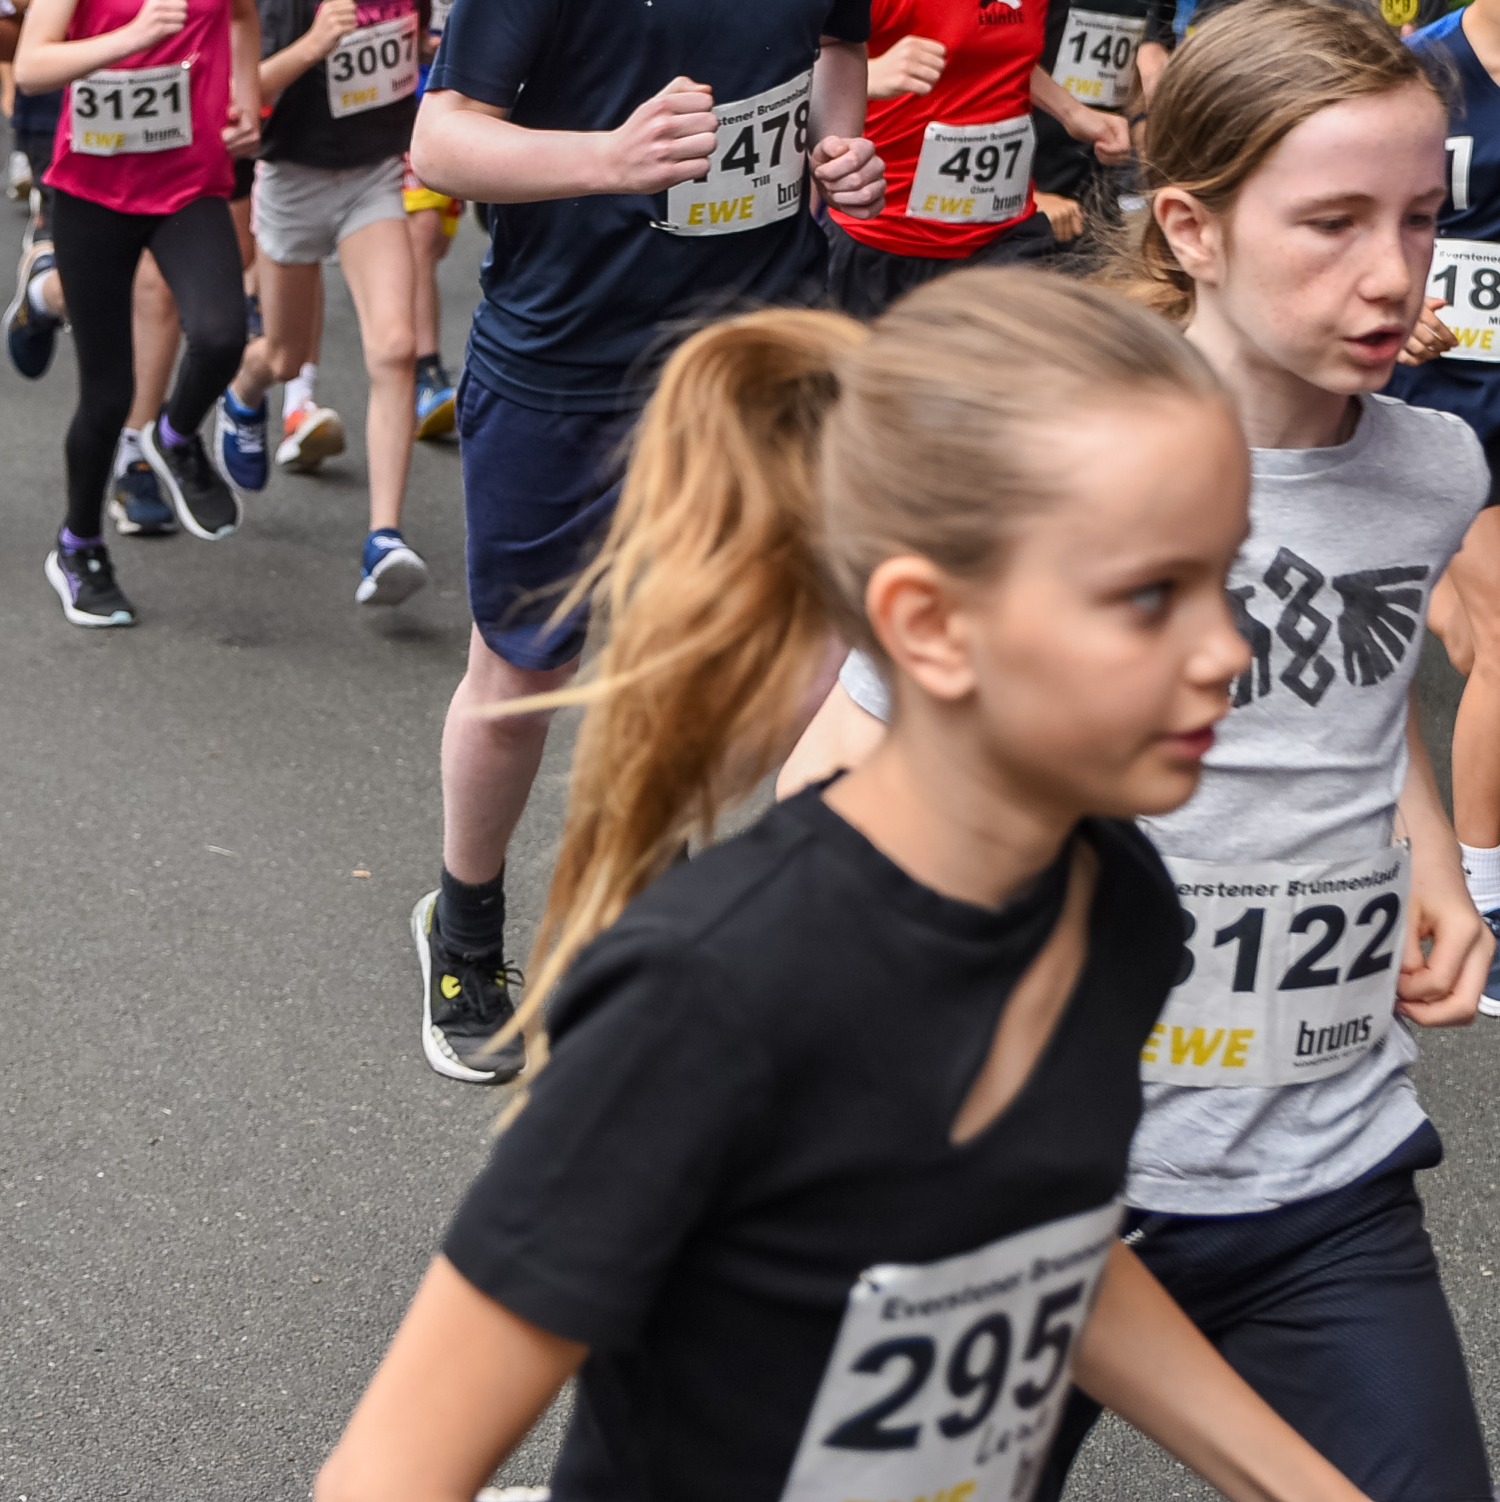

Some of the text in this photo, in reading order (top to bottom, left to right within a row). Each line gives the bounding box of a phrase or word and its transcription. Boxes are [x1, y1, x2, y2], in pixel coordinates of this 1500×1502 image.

[332, 31, 416, 83] 3007
[1069, 30, 1138, 70] 140
[76, 81, 181, 120] 3121
[718, 109, 754, 128] stener
[693, 100, 810, 183] 478
[938, 140, 1023, 183] 497
[752, 174, 770, 188] Till
[778, 181, 801, 205] bru
[687, 195, 755, 225] EWE
[923, 194, 976, 215] EWE
[1450, 327, 1495, 350] WE
[1177, 861, 1401, 898] erstener Brunnenlauf
[1296, 1014, 1374, 1056] bruns
[822, 1280, 1085, 1452] 295
